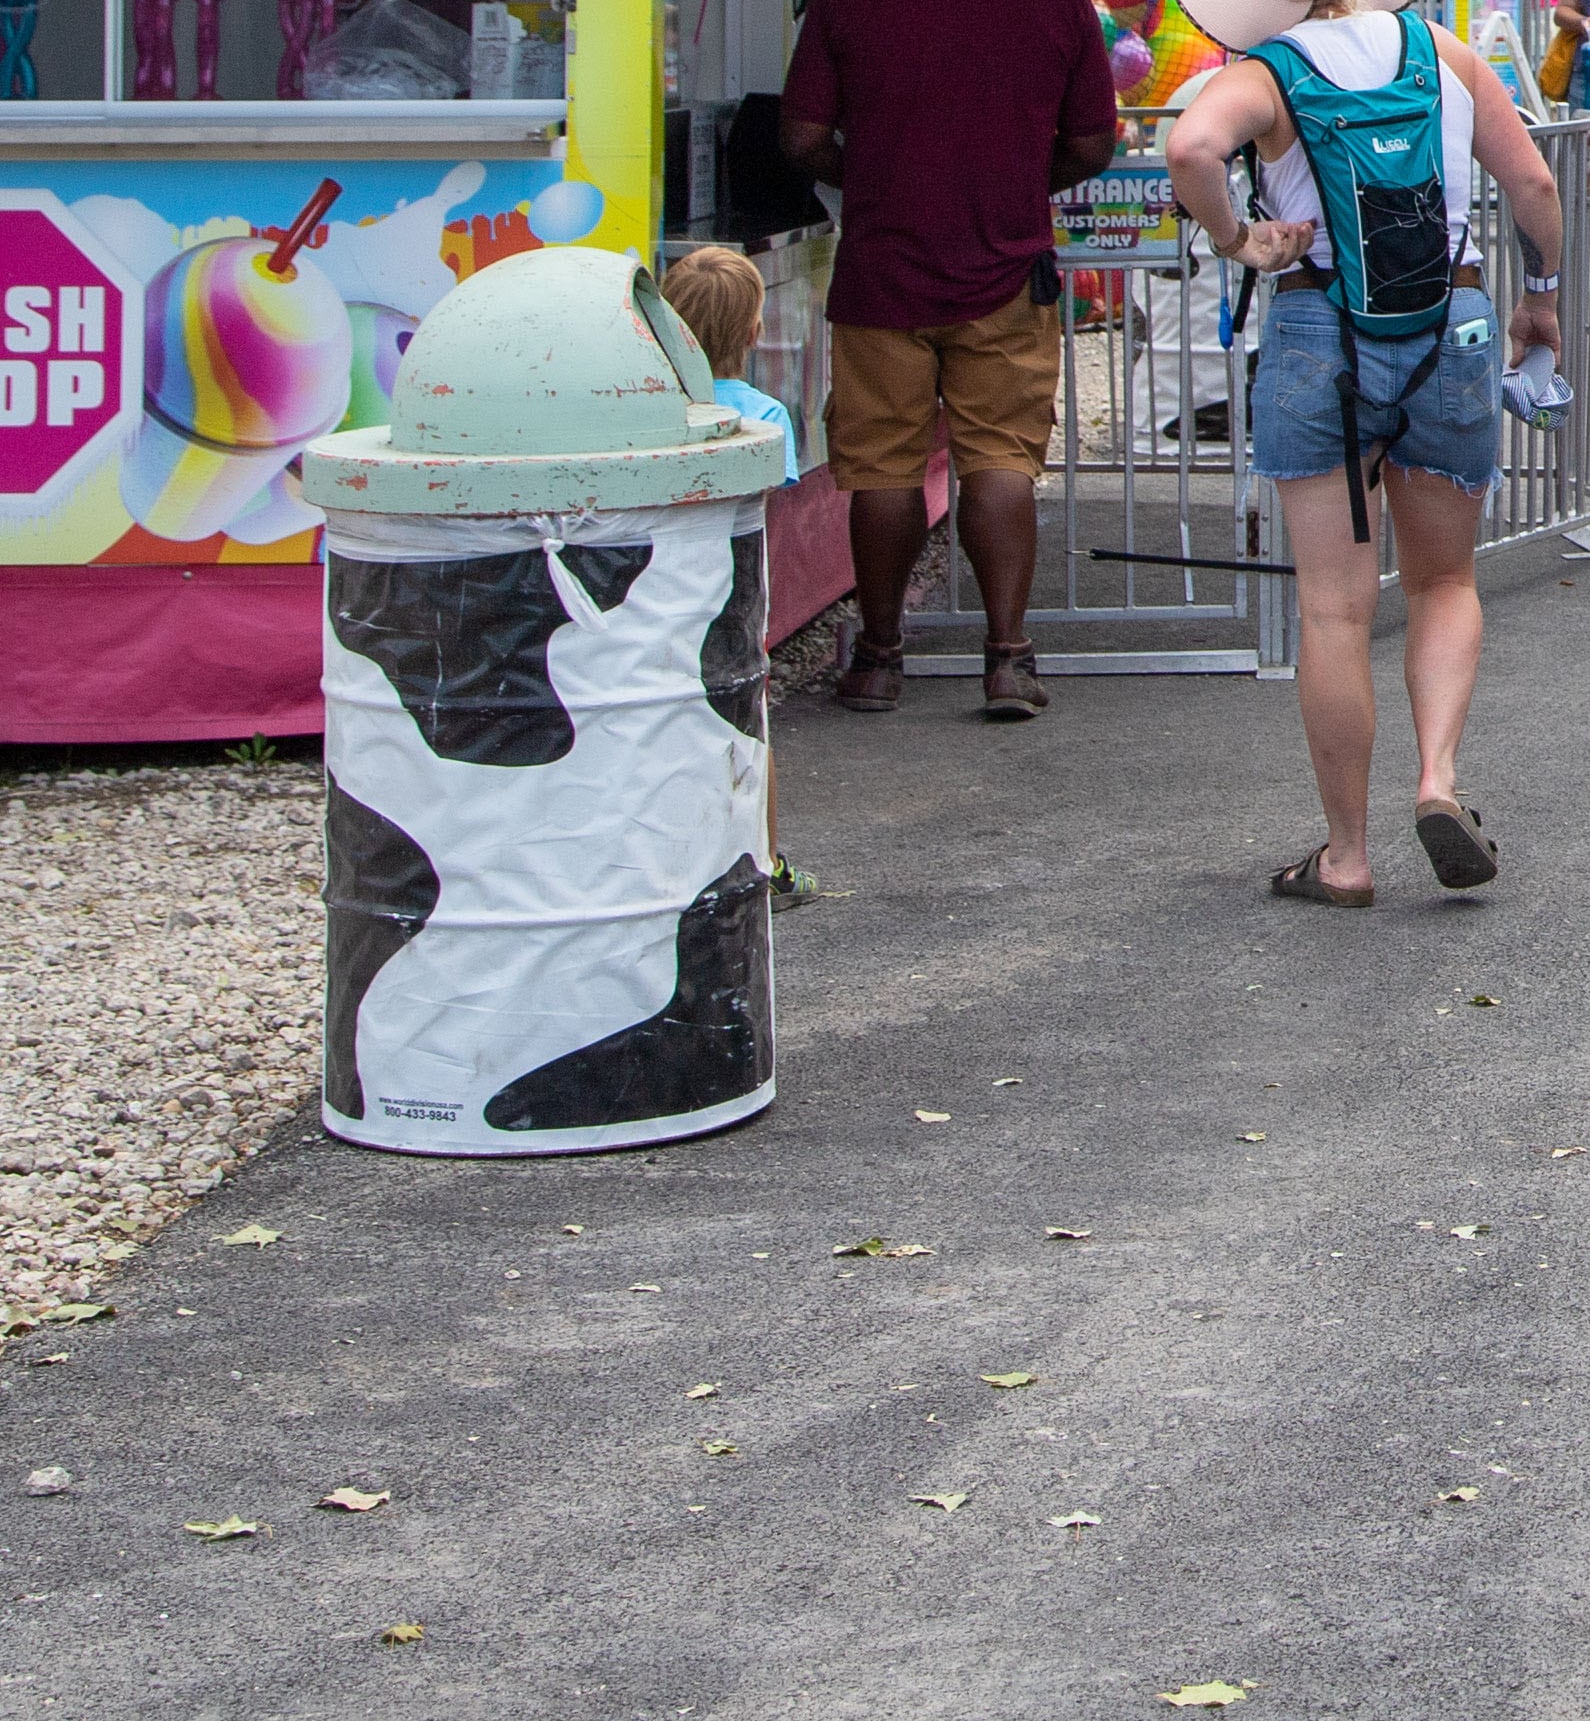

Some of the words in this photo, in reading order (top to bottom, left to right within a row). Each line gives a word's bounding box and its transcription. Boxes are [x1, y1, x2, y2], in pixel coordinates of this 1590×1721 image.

[1049, 178, 1173, 204] NTRANCE
[1053, 214, 1160, 229] CUSTOMERS
[1085, 234, 1132, 249] ONLY
[4, 285, 104, 353] SH
[384, 1106, 456, 1121] 800-433-9843
